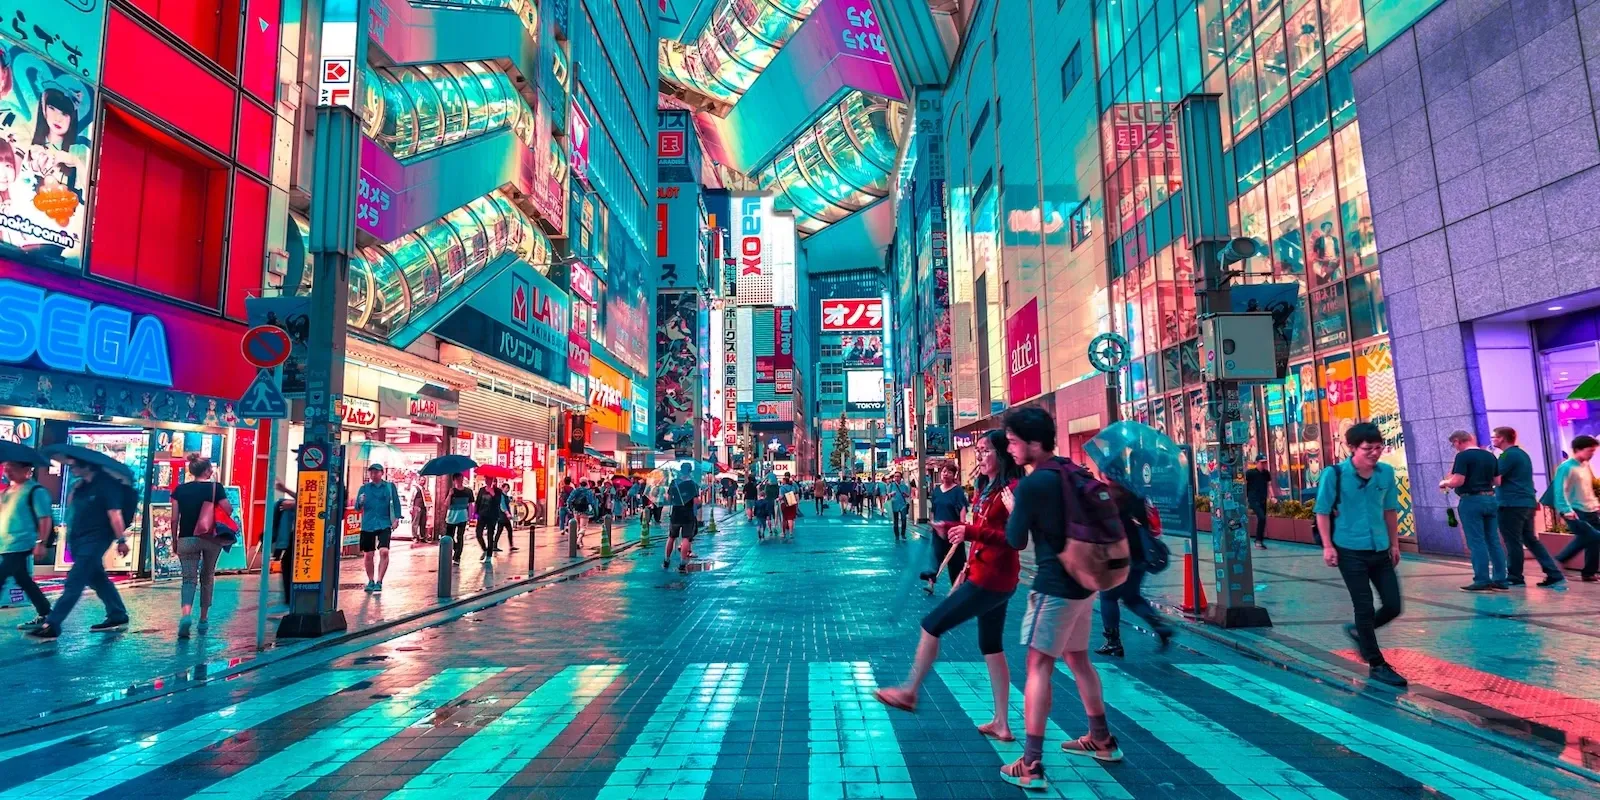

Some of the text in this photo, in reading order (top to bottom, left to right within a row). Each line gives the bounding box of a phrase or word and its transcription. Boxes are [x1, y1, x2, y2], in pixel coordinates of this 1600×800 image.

[0, 9, 90, 77] らです。
[359, 178, 389, 211] カメラ
[0, 278, 173, 386] SEGA
